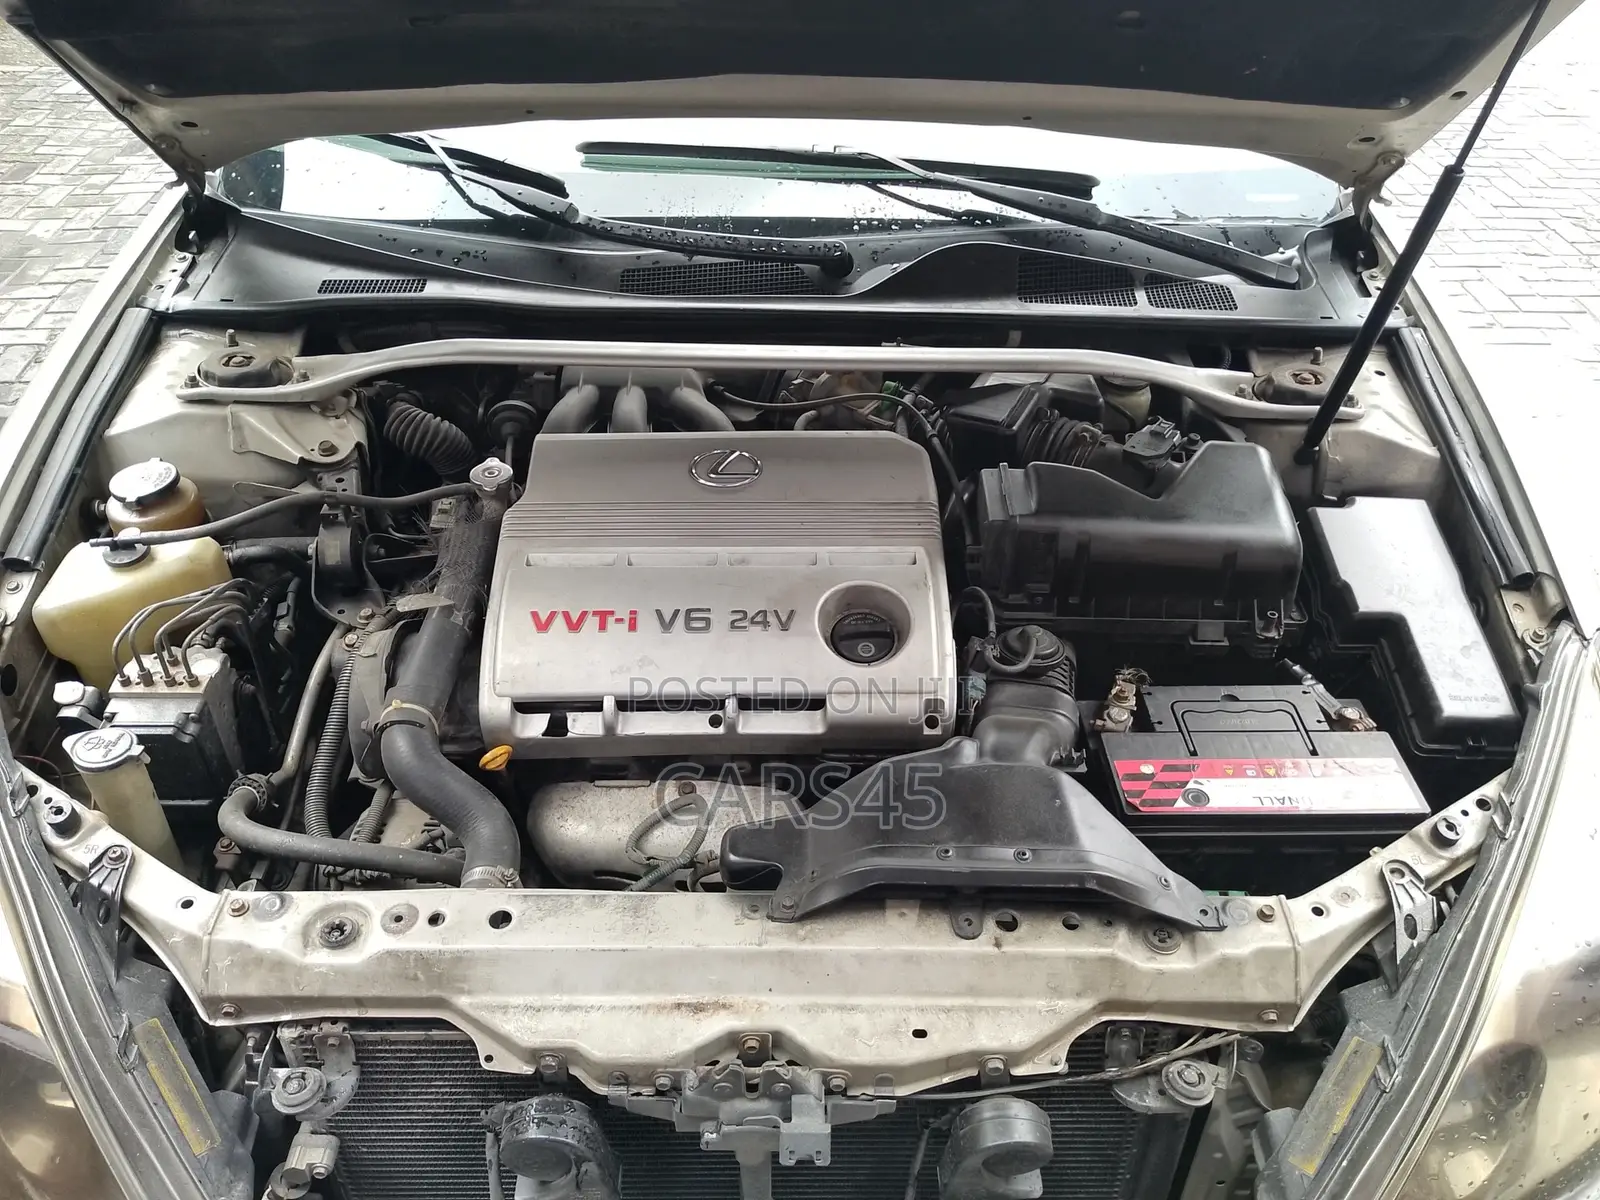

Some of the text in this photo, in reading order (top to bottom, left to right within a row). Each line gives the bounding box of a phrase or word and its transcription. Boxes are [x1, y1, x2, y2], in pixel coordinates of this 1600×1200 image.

[529, 607, 796, 633] VVT-i V6 24V
